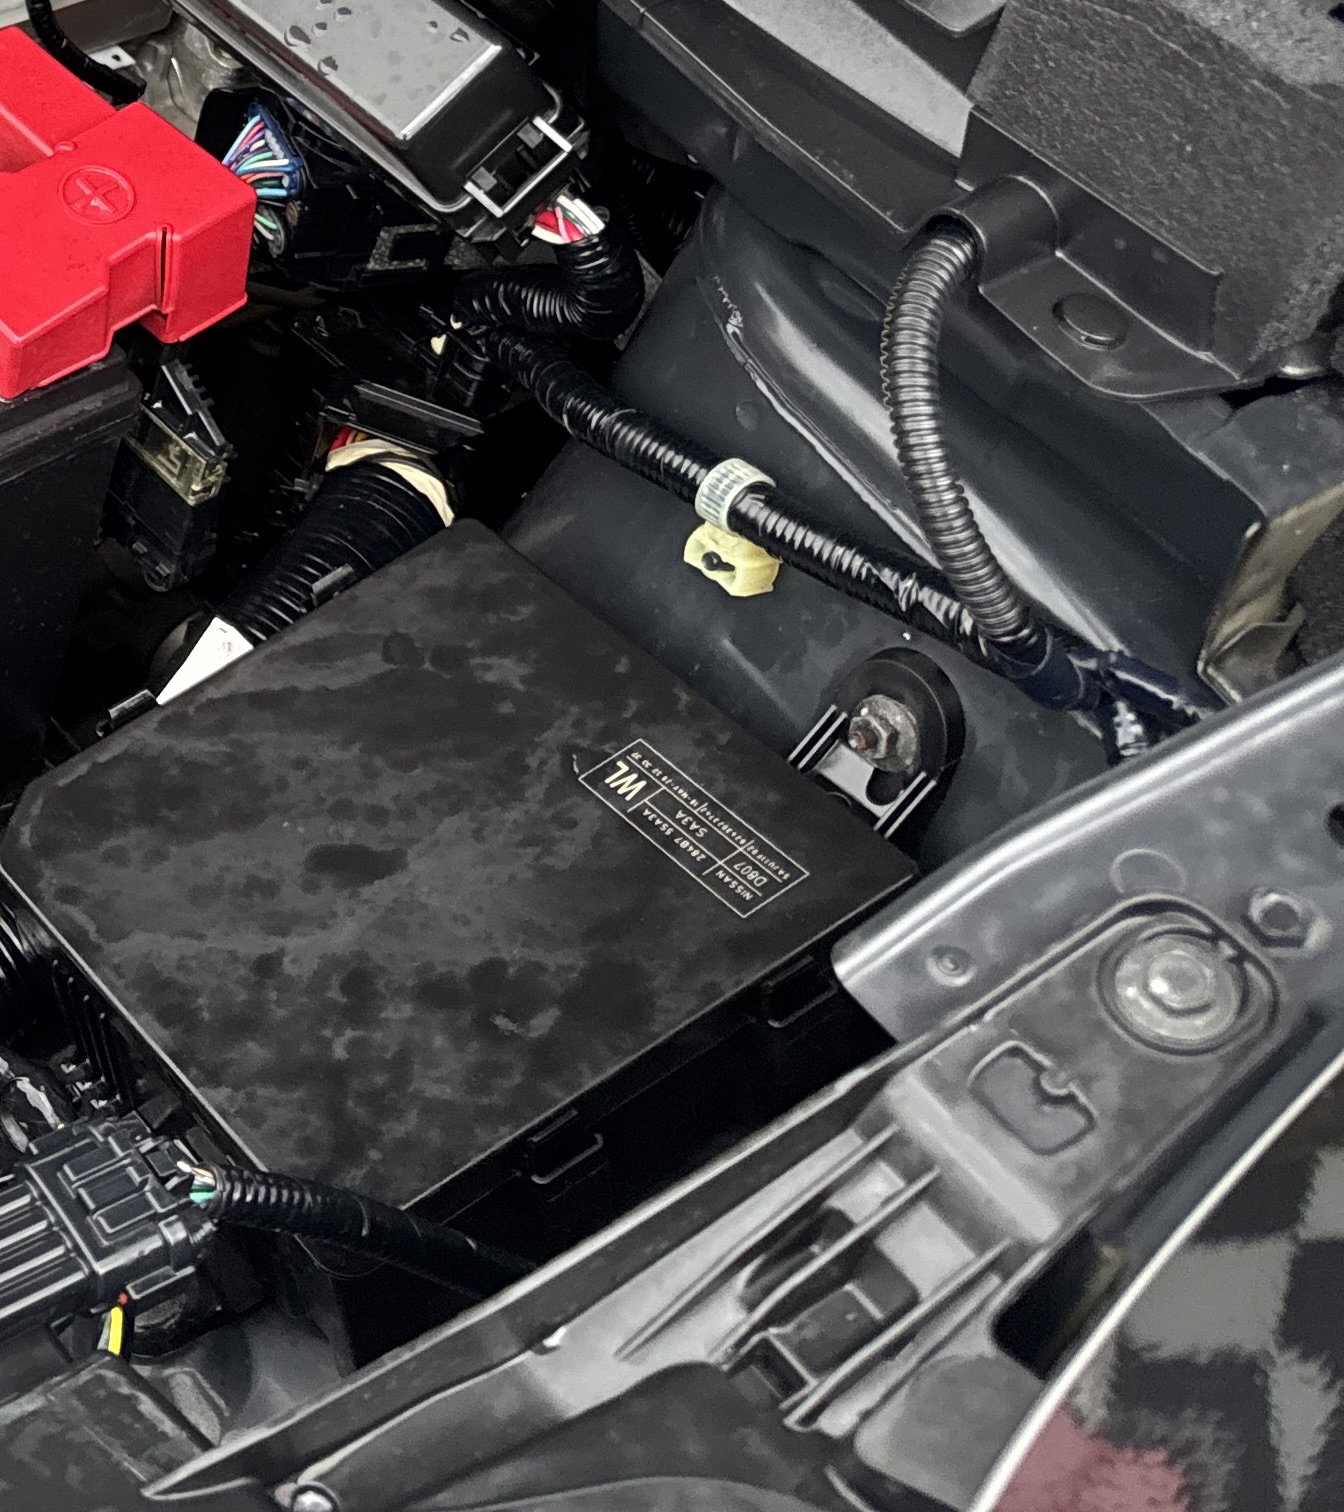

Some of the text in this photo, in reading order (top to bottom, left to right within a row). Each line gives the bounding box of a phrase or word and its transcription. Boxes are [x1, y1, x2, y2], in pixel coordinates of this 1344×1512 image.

[601, 758, 648, 802] WL
[673, 808, 709, 838] SA3A
[714, 868, 754, 902] NISSAN
